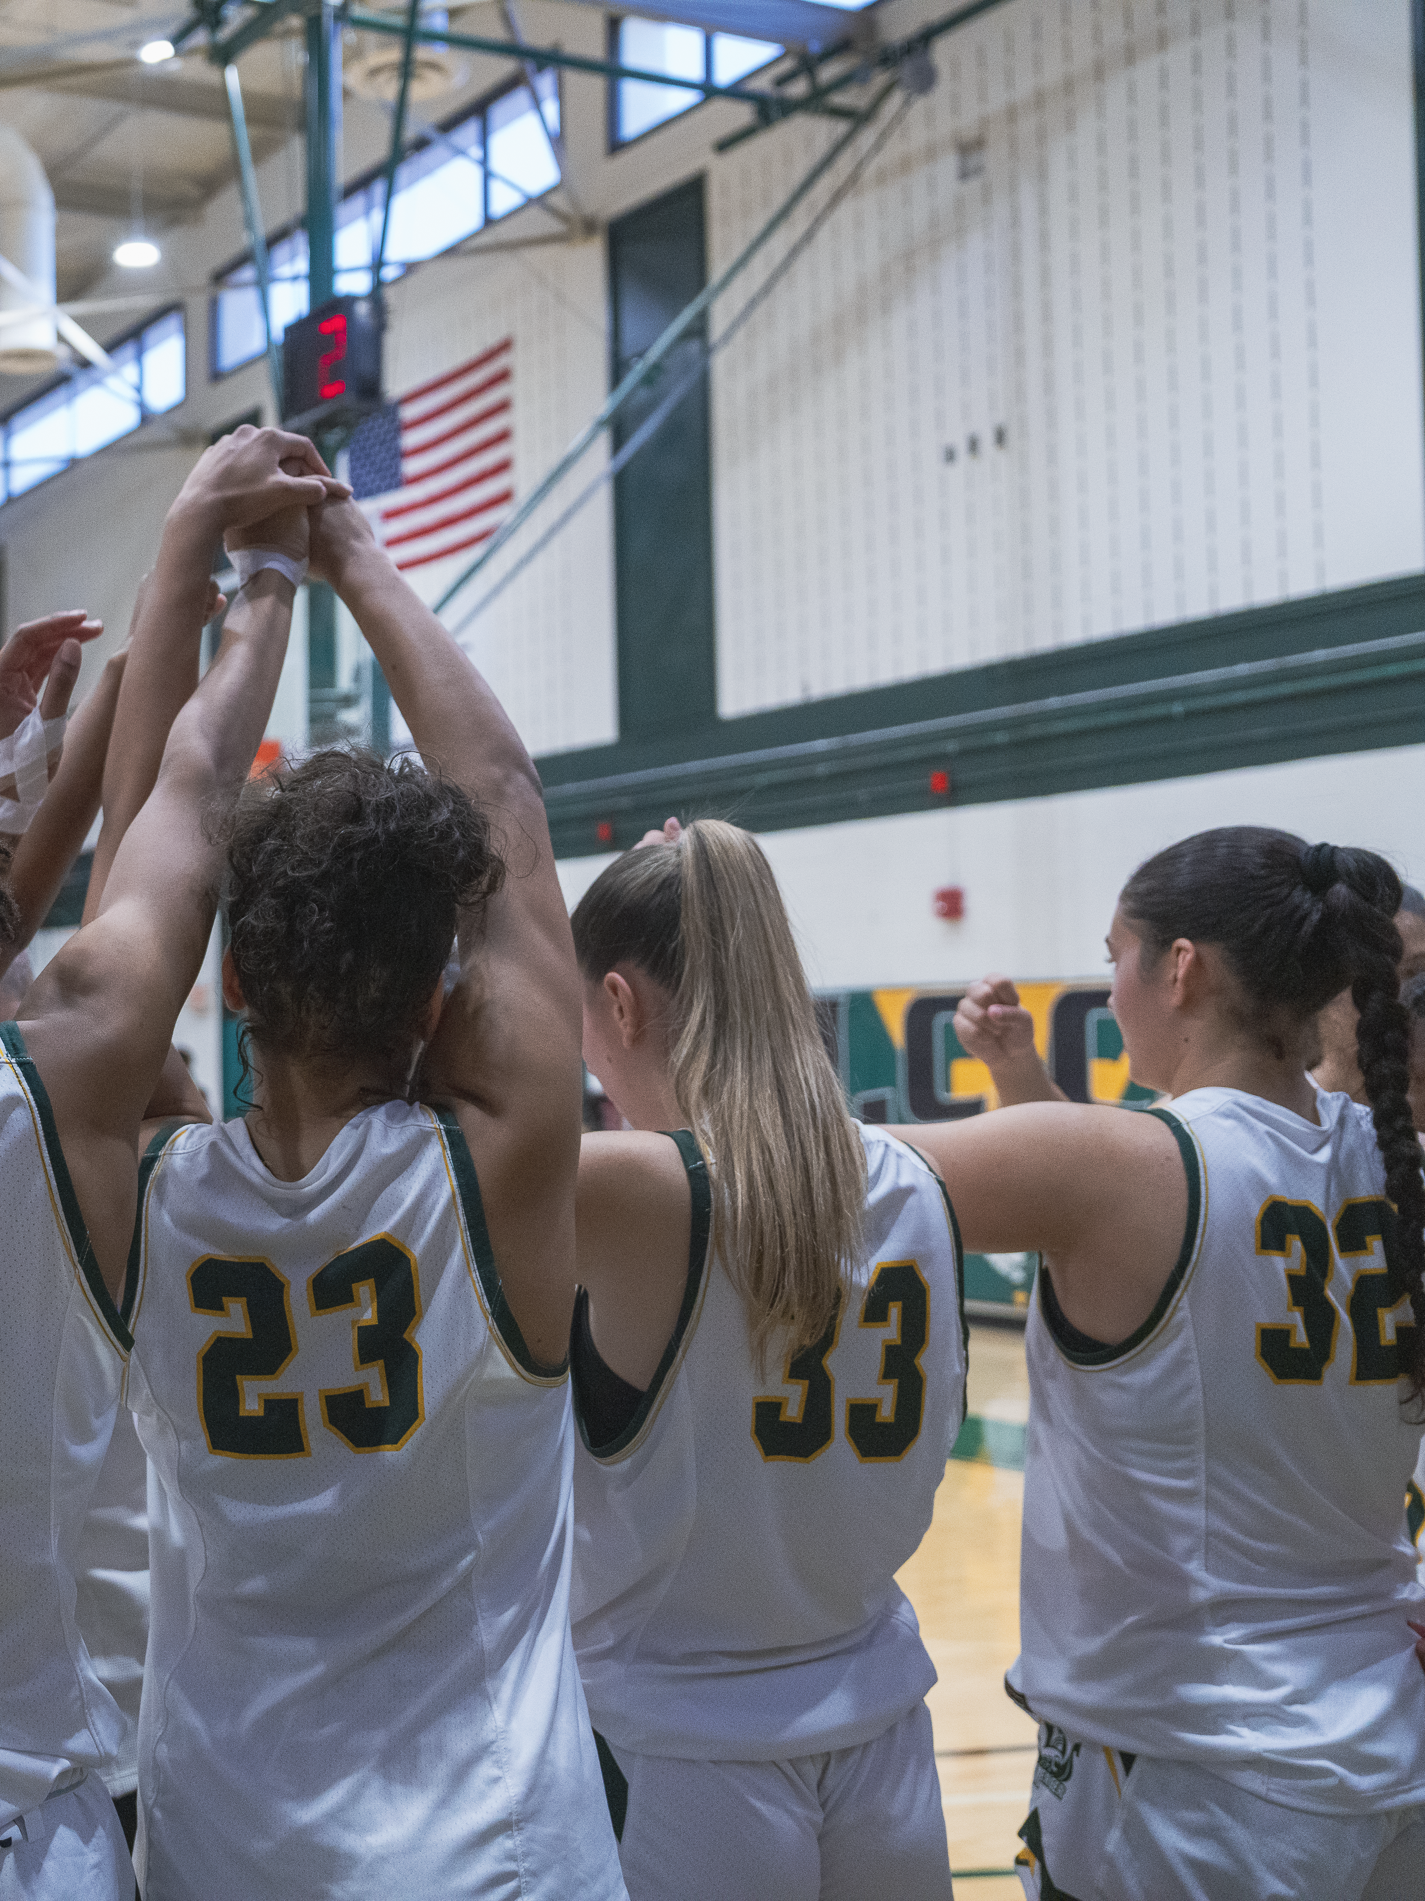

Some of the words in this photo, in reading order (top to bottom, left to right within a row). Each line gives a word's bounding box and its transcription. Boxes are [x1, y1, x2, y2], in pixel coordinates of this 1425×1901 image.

[318, 313, 348, 400] 2
[186, 1231, 426, 1460] 23
[1255, 1194, 1416, 1386] 32
